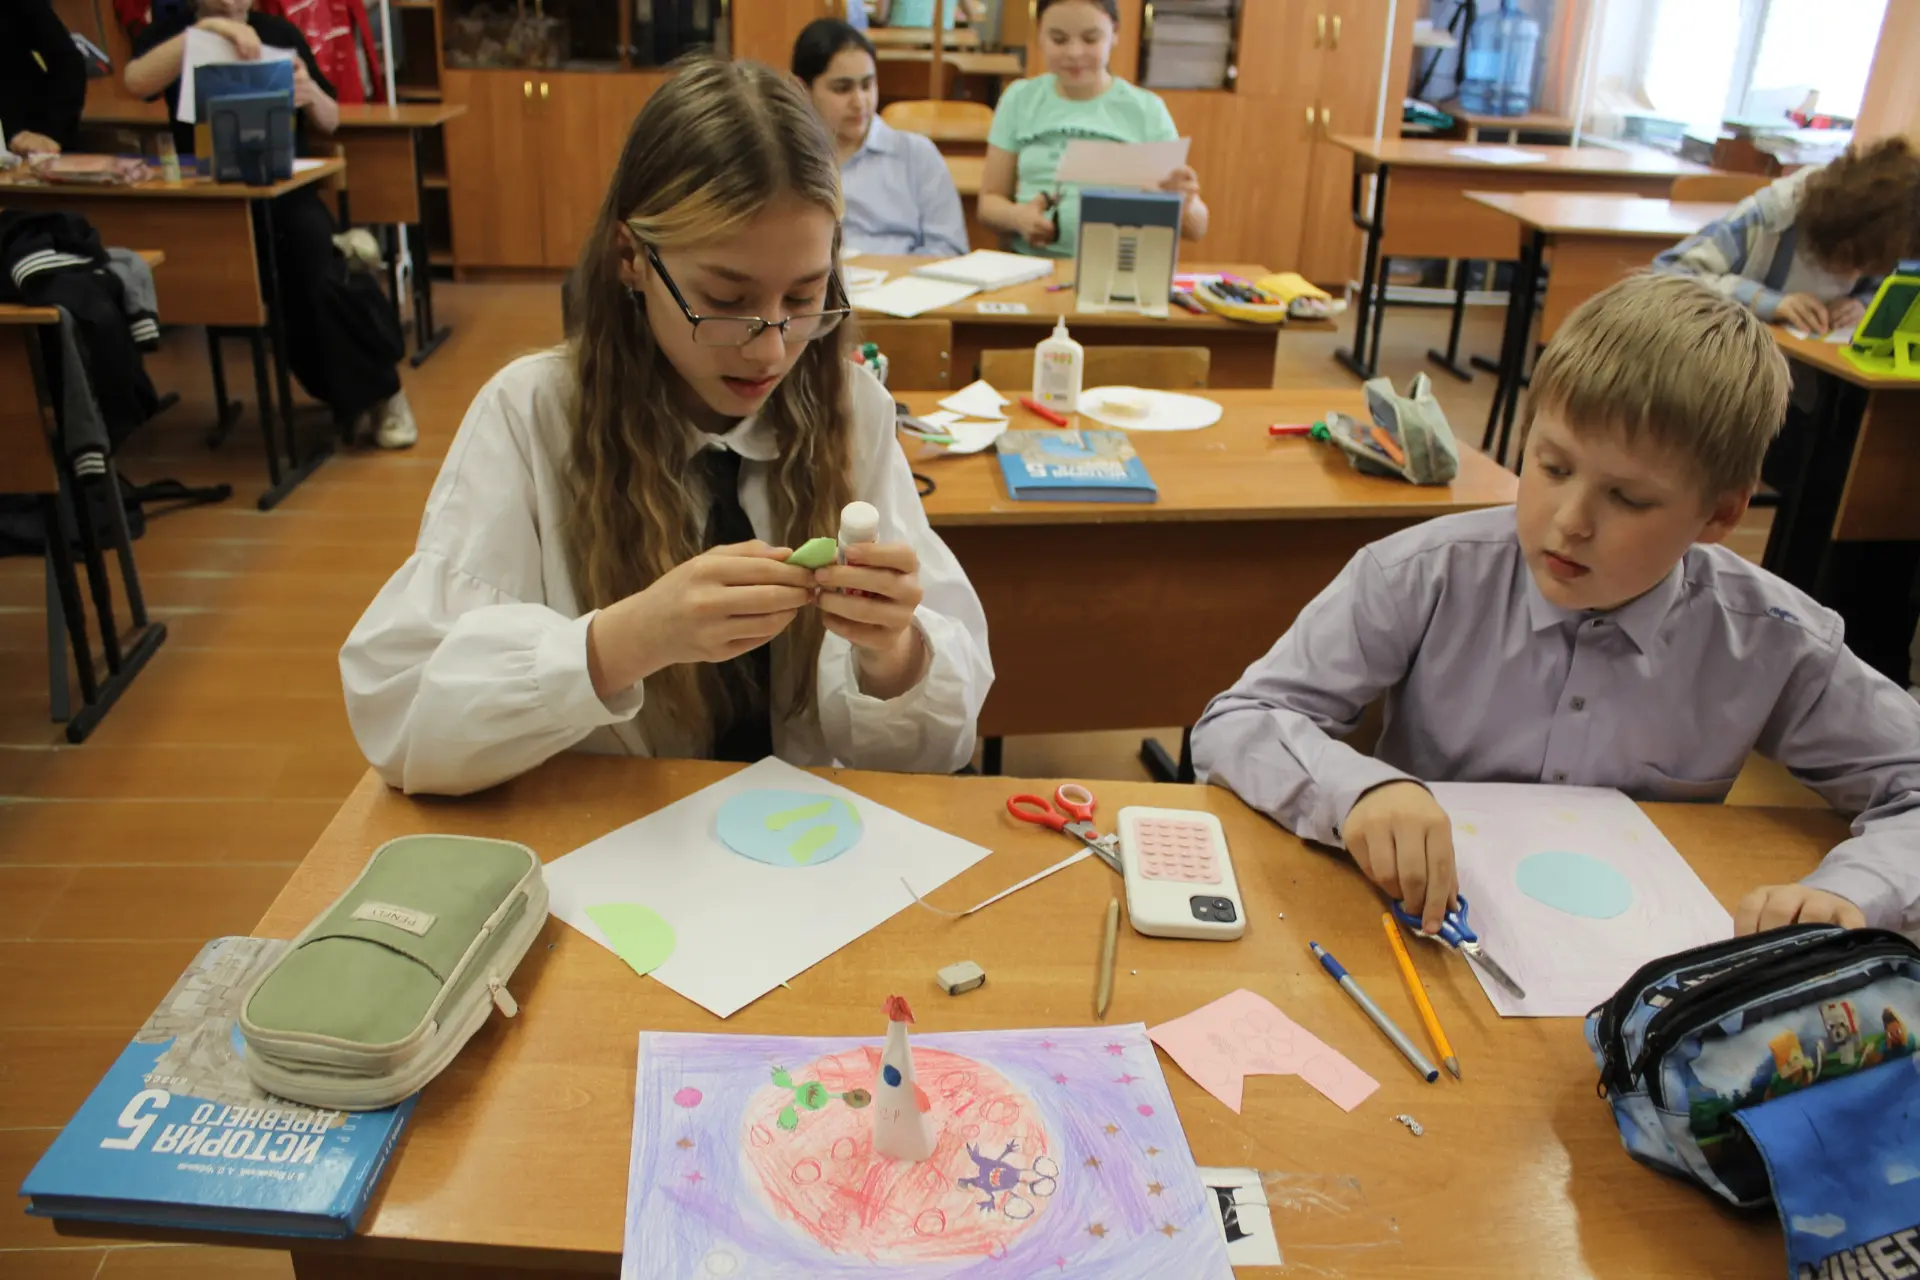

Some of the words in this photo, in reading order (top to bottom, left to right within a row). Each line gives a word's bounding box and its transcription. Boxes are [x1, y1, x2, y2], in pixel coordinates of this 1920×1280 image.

[99, 1088, 172, 1151] 5
[190, 1103, 340, 1134] ДРЕВНЕГО
[151, 1123, 325, 1164] ИСТОРИЯ
